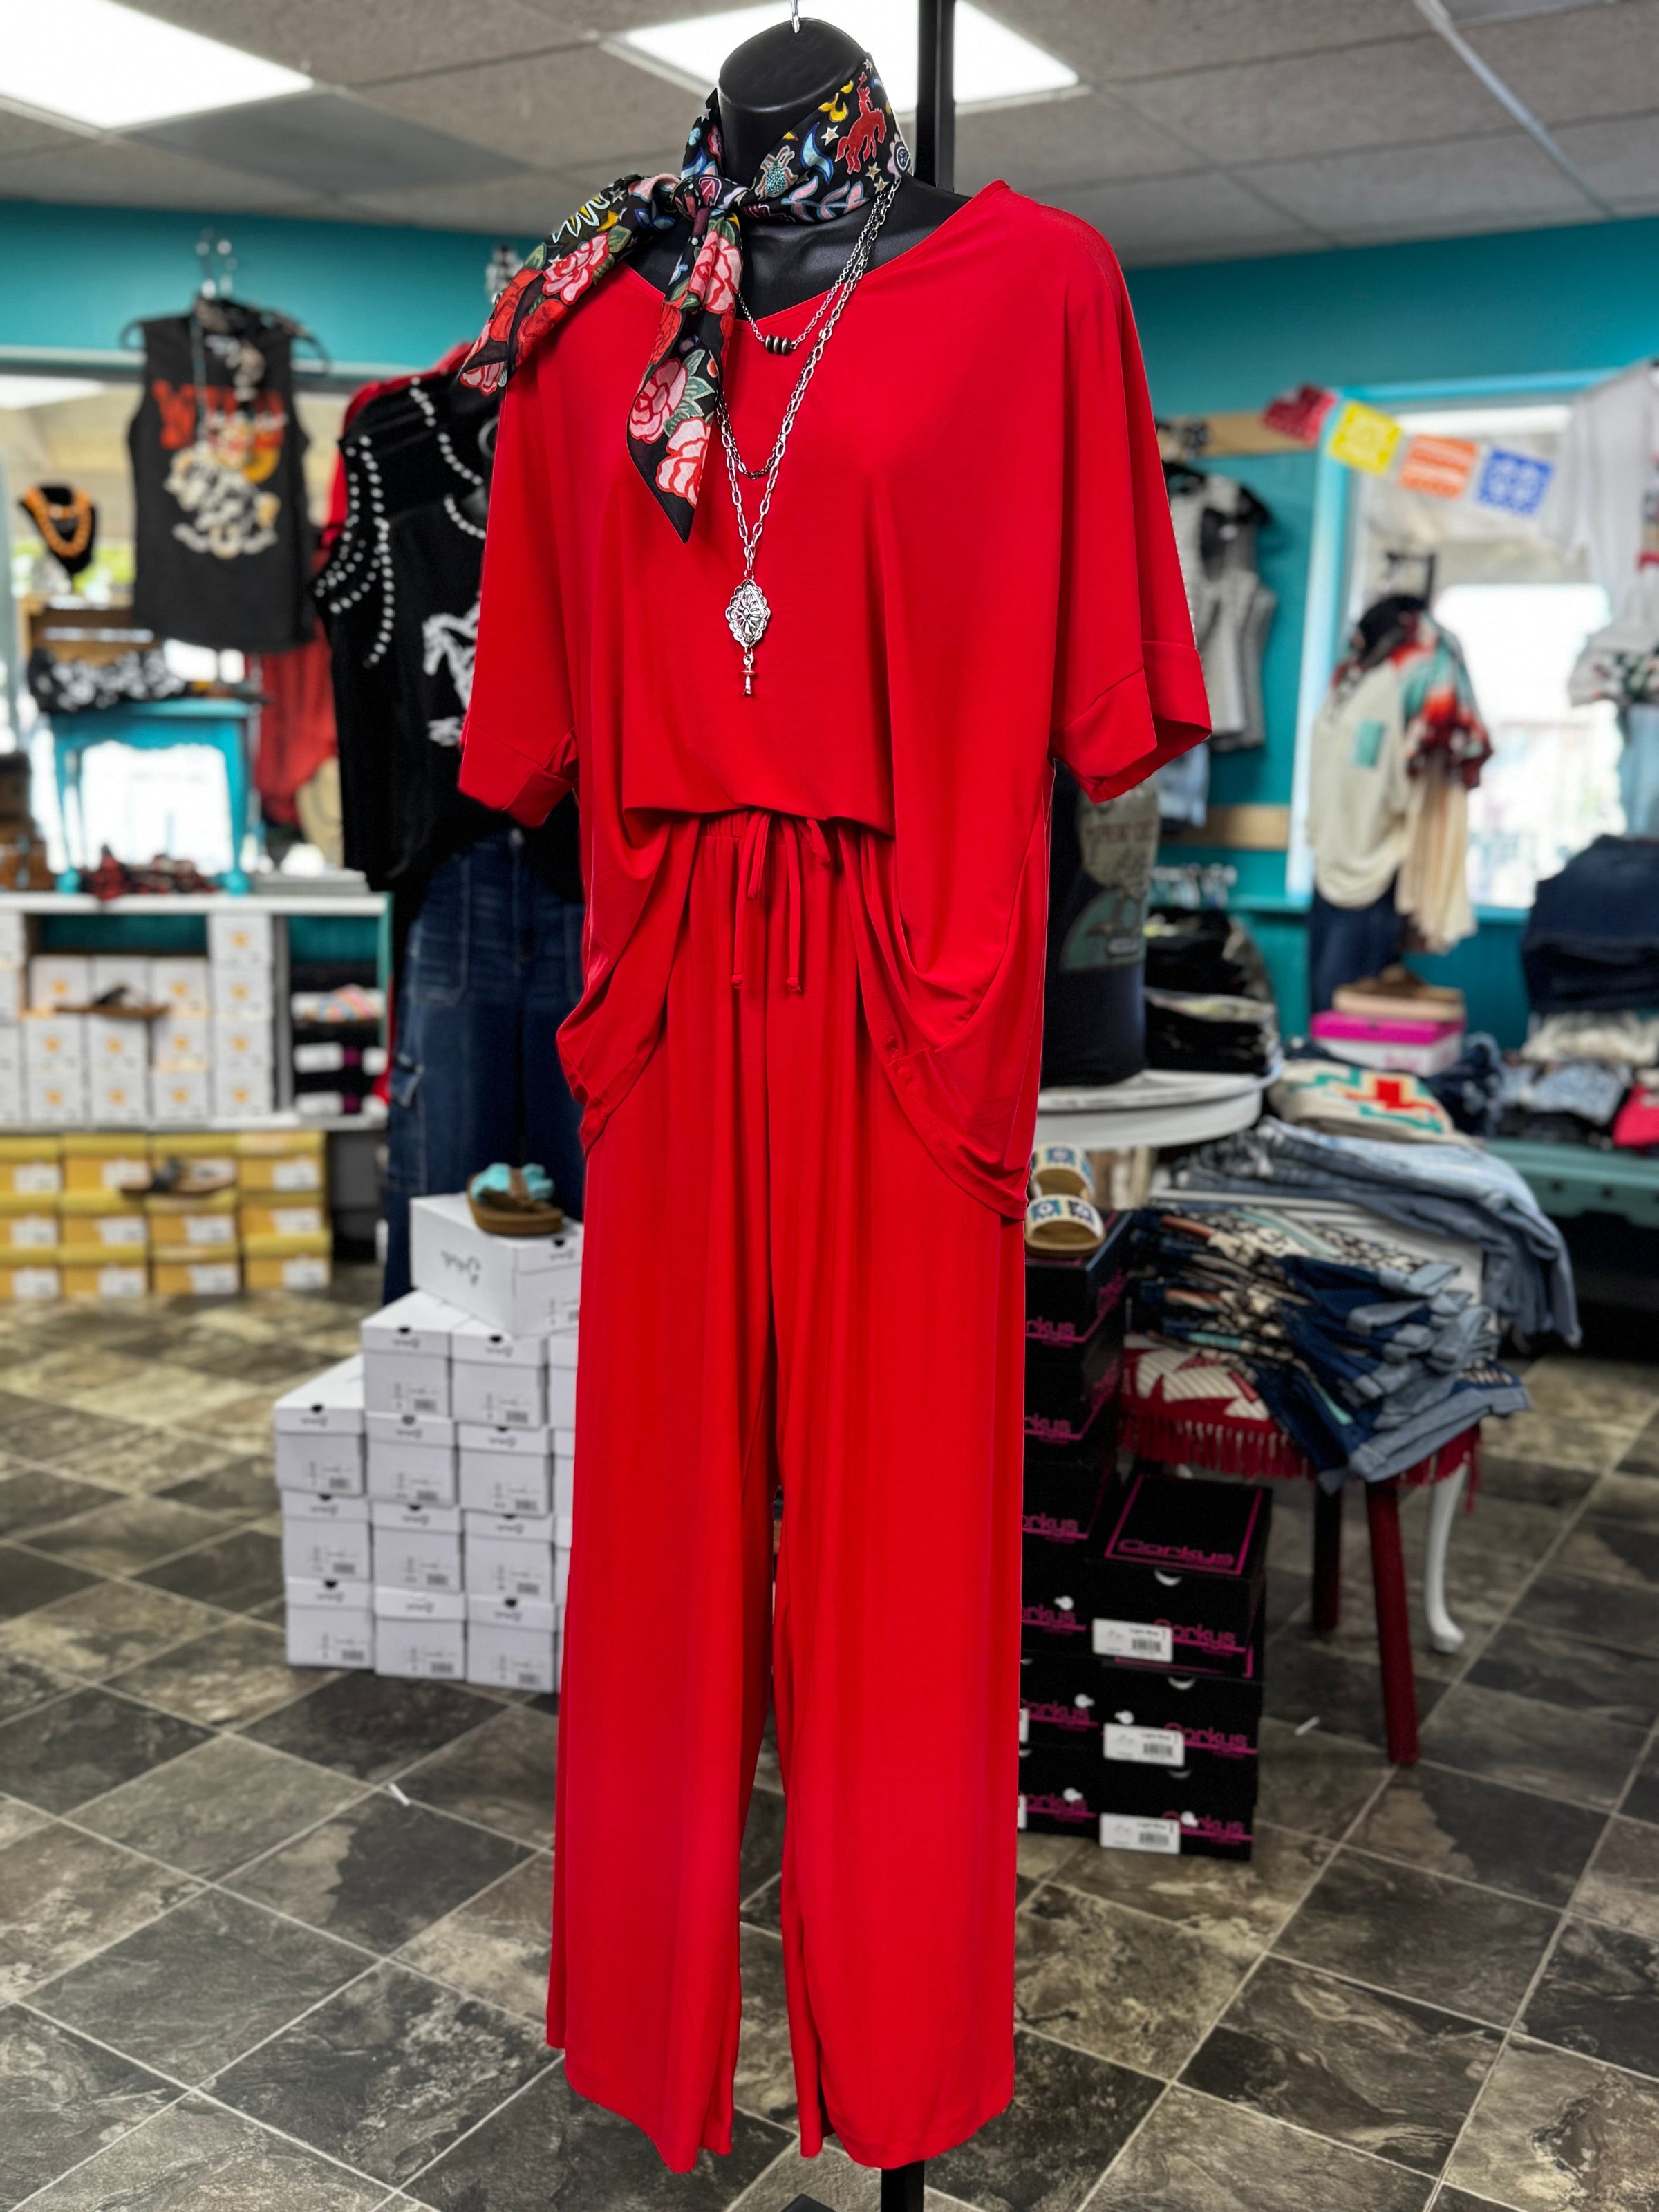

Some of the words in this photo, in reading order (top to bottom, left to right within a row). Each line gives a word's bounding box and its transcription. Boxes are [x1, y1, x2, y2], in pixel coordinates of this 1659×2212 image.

[1026, 1316, 1076, 1342] rkys
[1154, 1618, 1237, 1651] orkys
[1020, 1698, 1090, 1725] orkys
[1163, 1721, 1248, 1752] orkys
